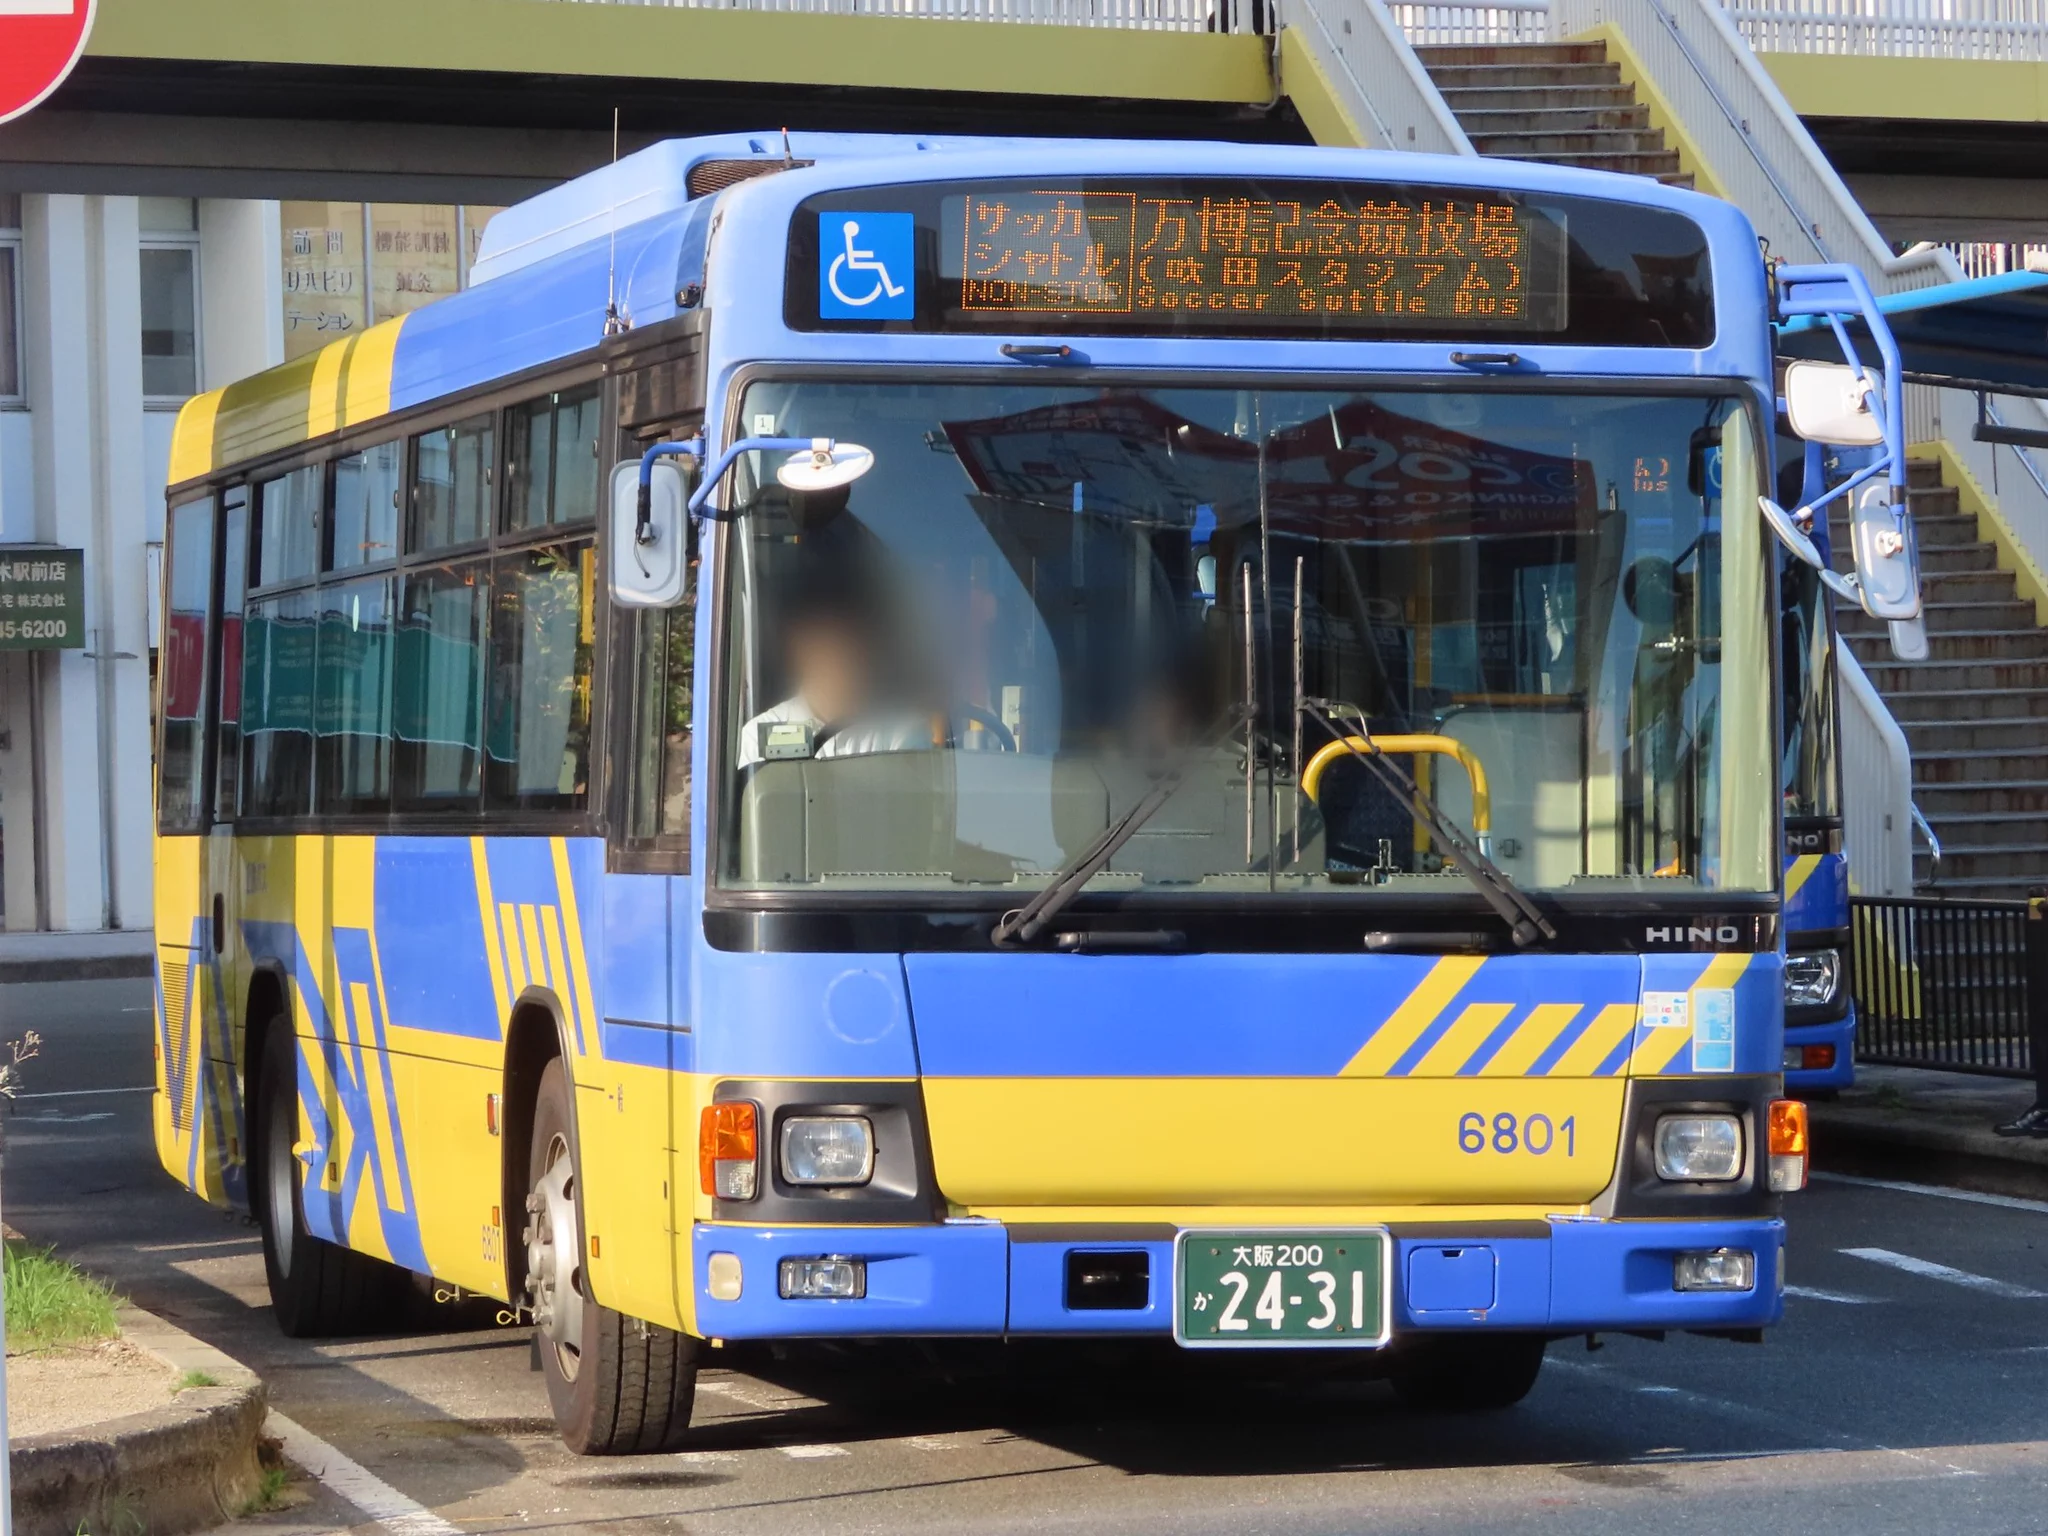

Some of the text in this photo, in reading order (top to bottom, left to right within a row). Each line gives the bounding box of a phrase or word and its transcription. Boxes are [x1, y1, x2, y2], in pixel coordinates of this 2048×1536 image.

[976, 200, 1119, 236] サッカー
[1141, 197, 1519, 257] 万博記念競技場
[974, 242, 1120, 276] シャトル
[968, 279, 1122, 303] NON-STOP
[1138, 285, 1519, 314] Soccer Suttle Bus
[288, 311, 354, 331] テーション
[1646, 926, 1739, 943] HINO
[1458, 1112, 1575, 1157] 6801
[1218, 1270, 1364, 1331] 24-31
